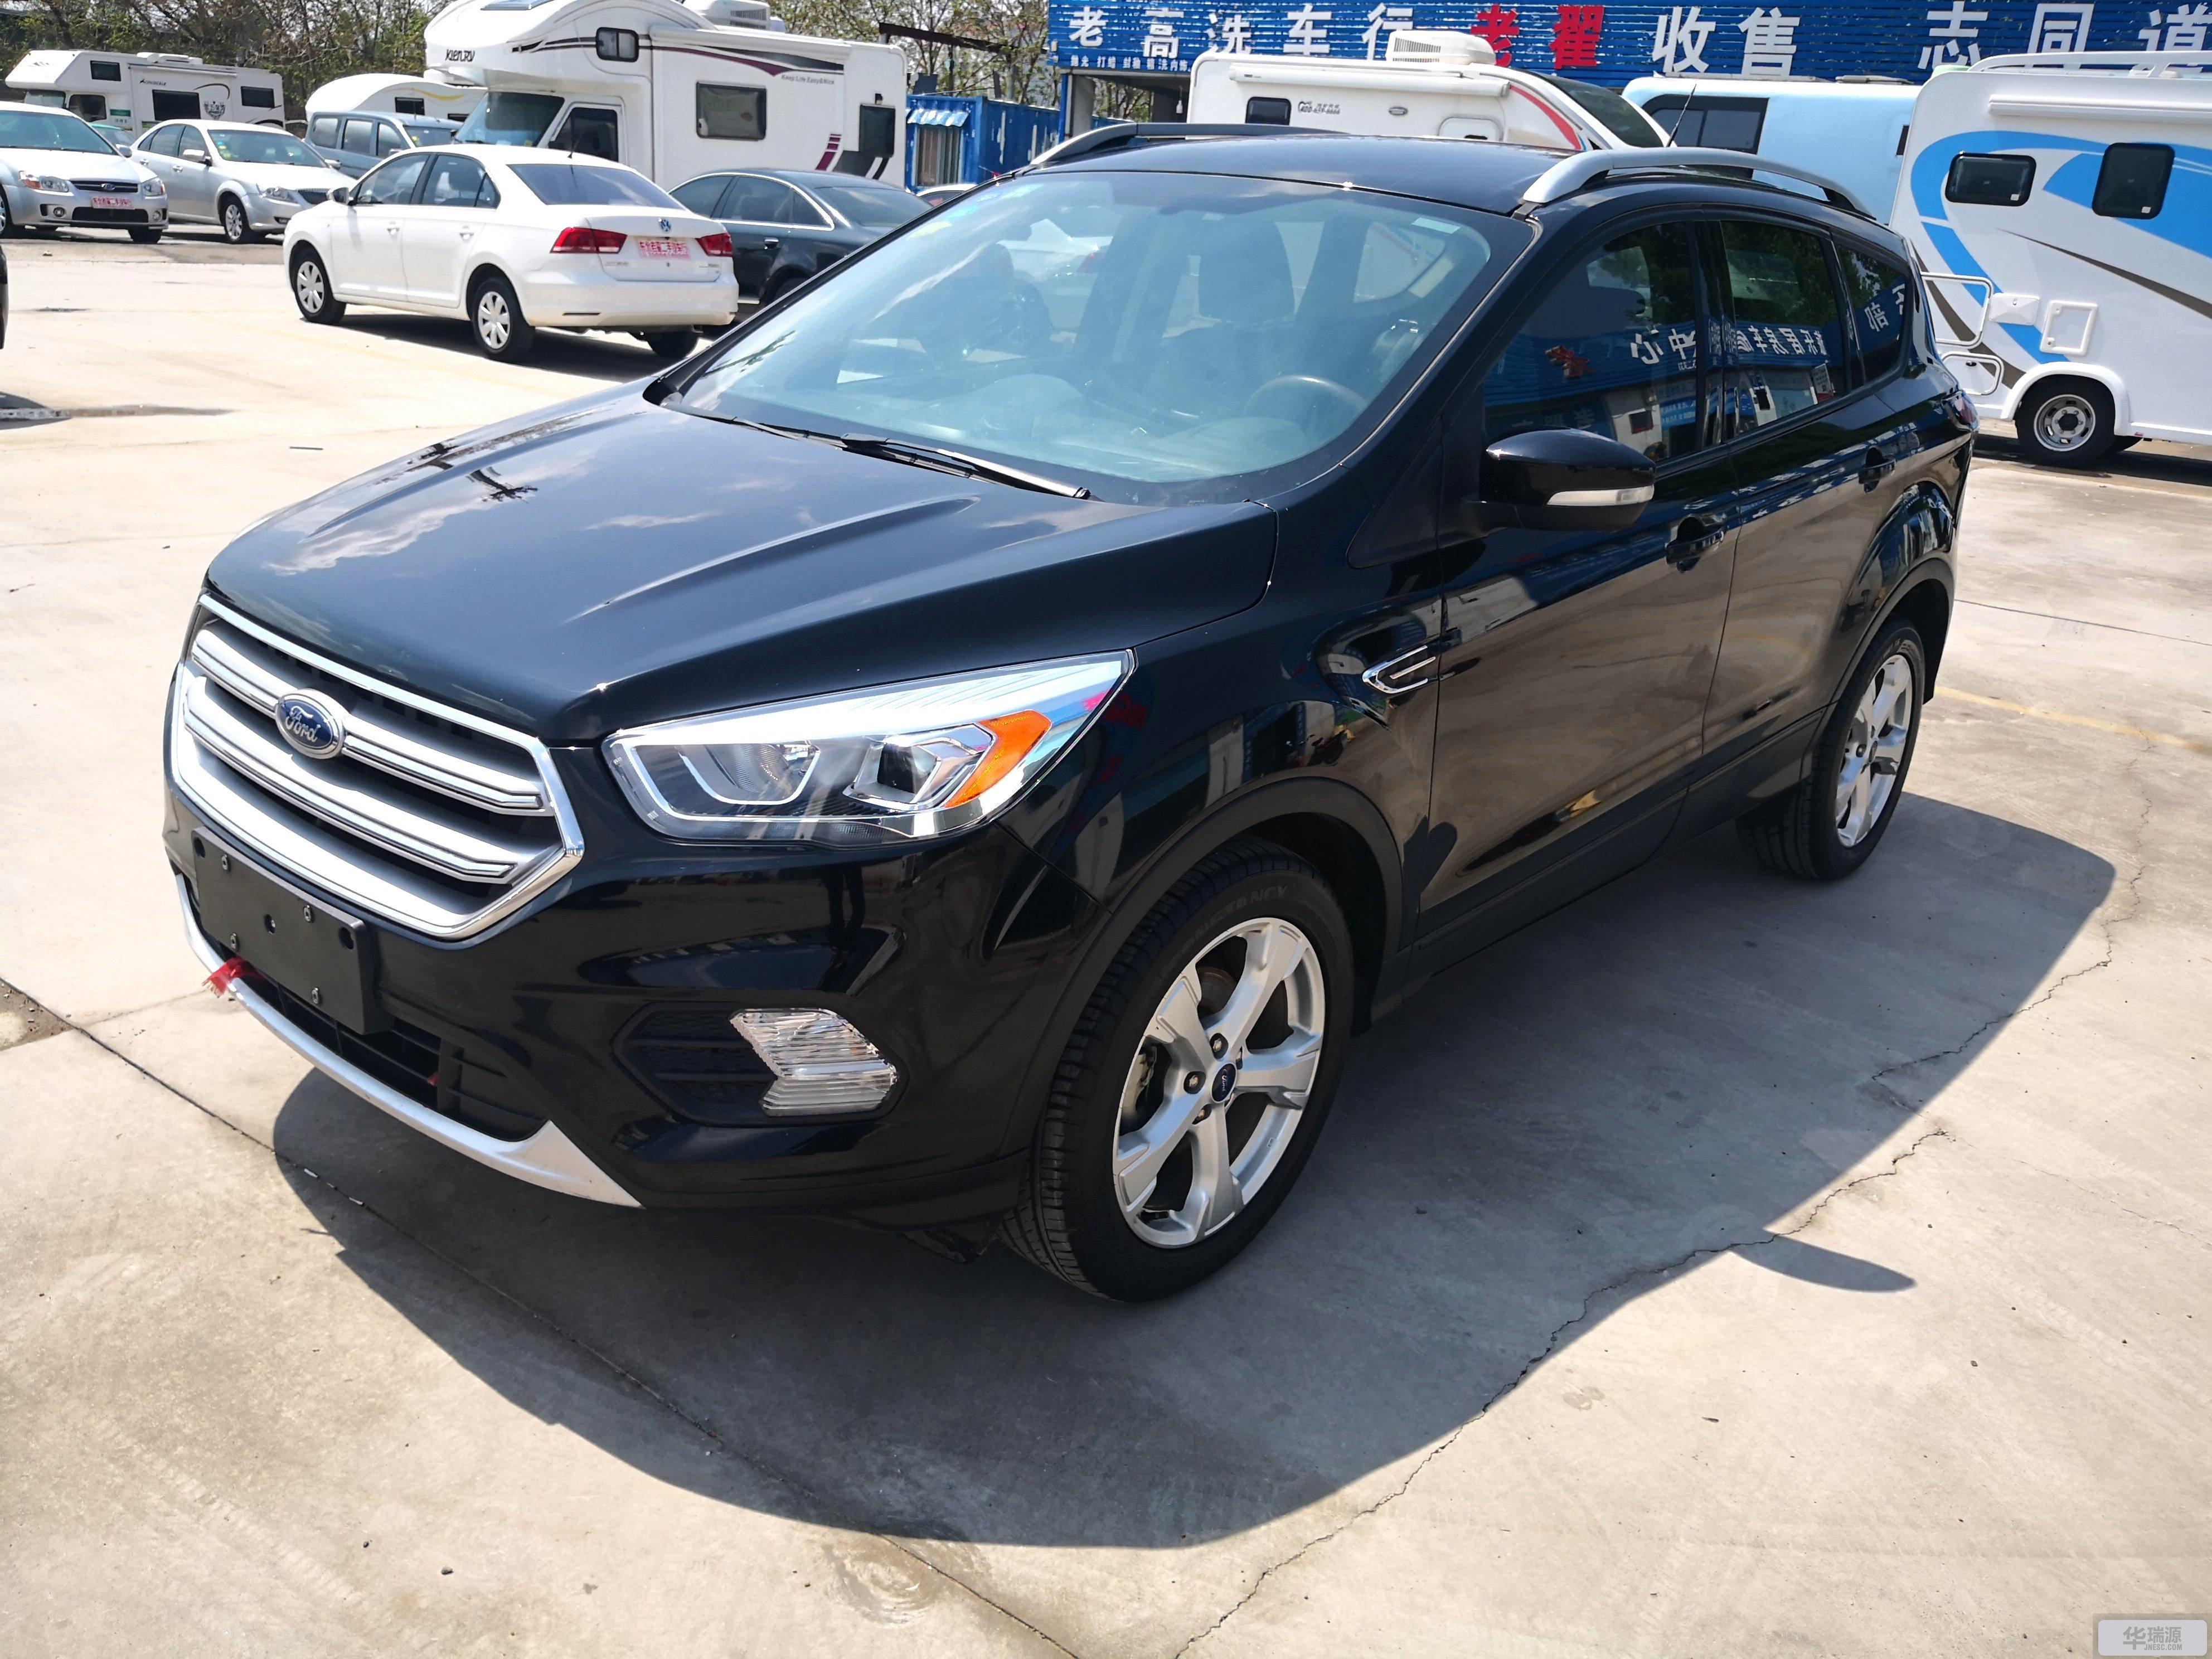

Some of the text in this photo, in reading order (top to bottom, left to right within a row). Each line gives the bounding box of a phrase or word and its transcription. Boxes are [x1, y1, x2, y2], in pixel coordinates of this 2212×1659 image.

[1069, 3, 1413, 60] 老高洗车行
[285, 705, 322, 743] Ford
